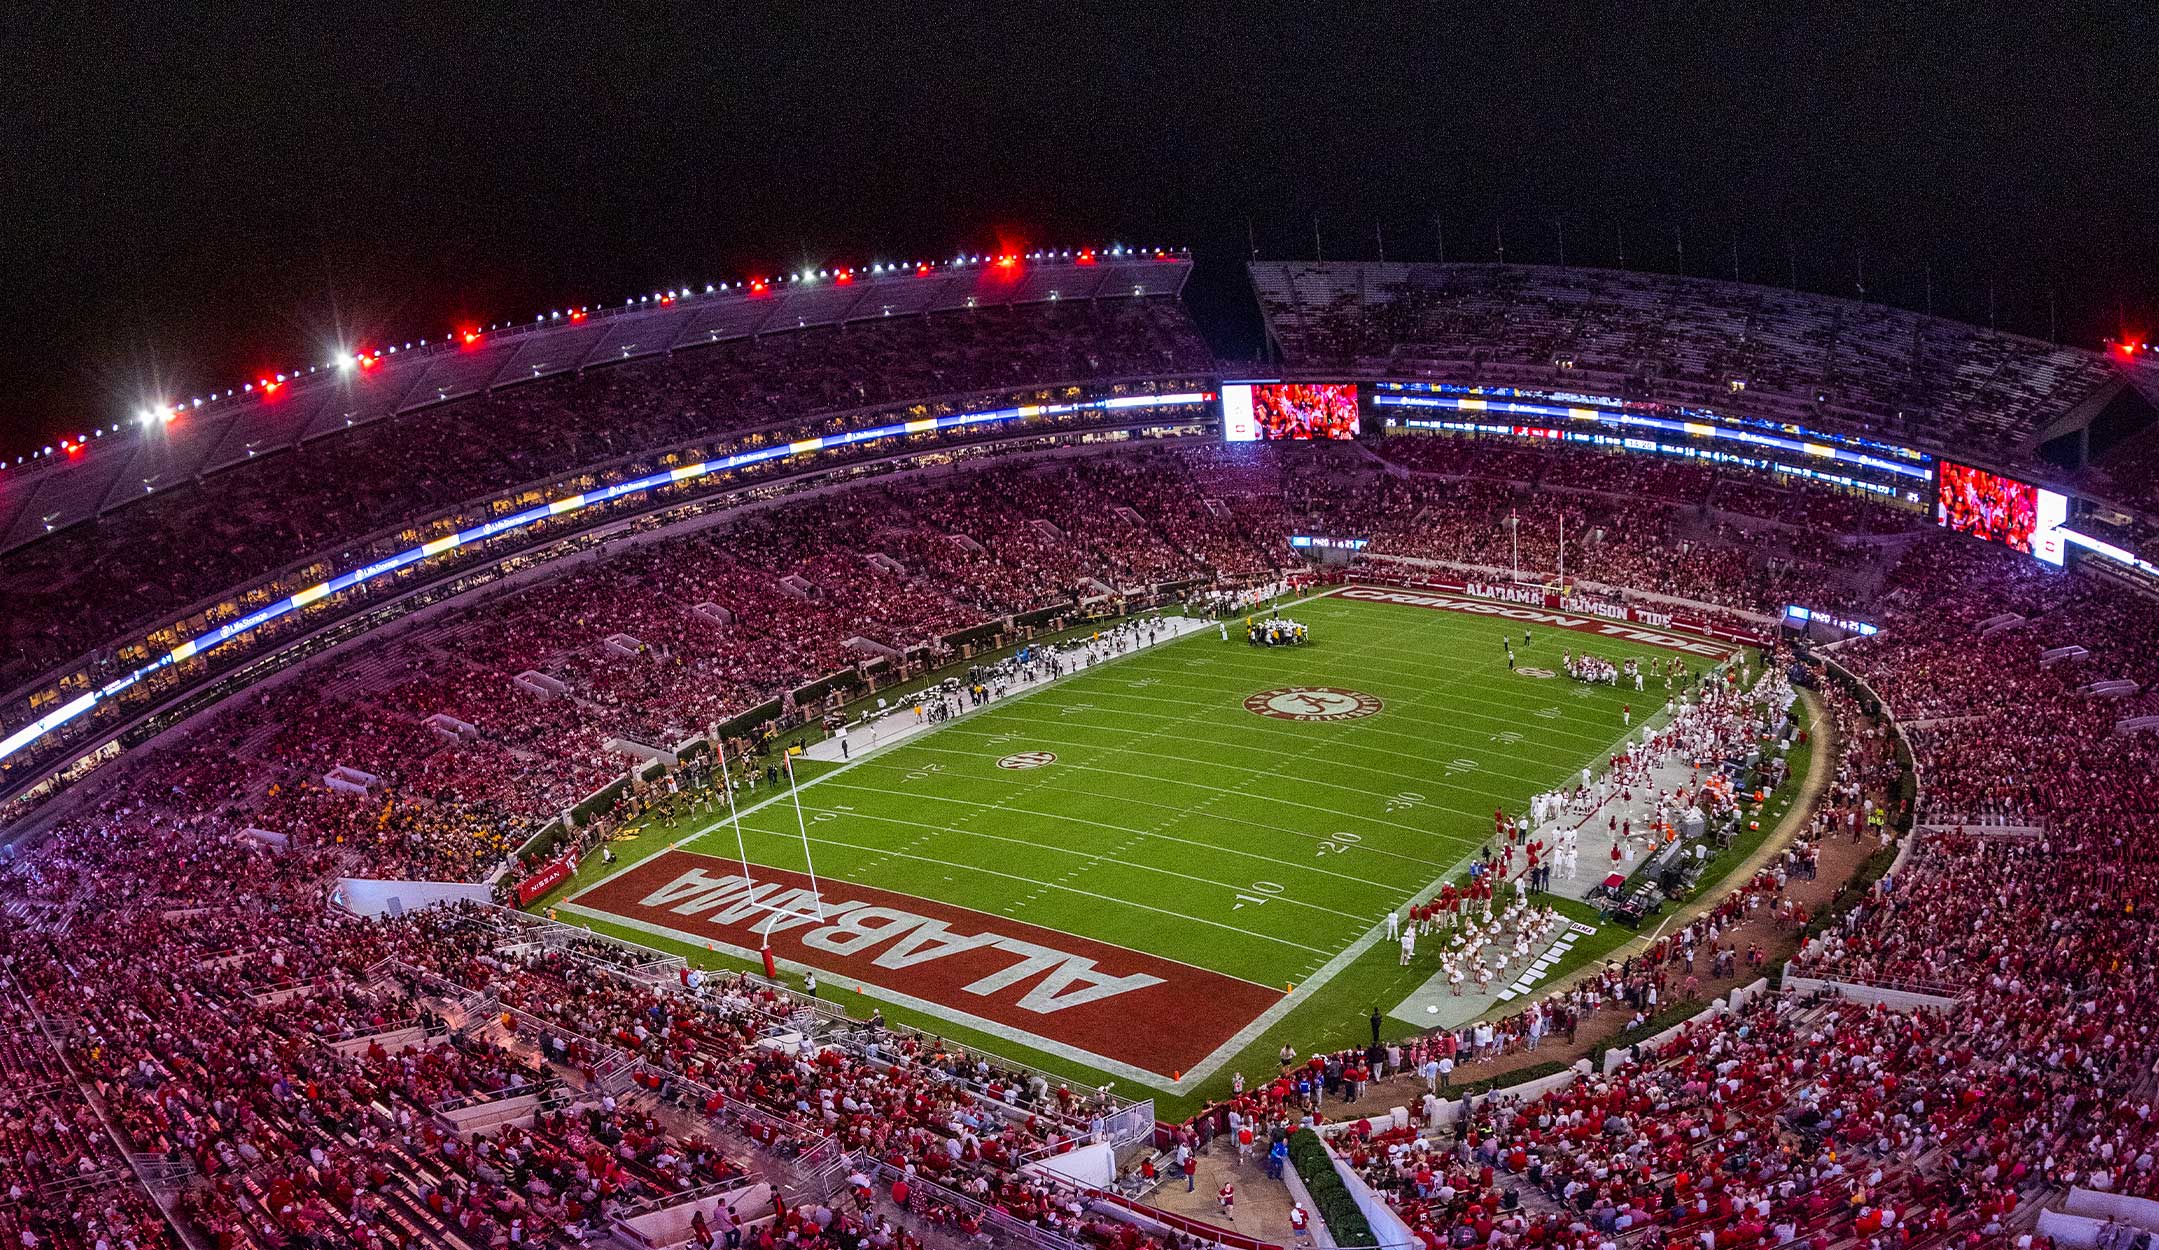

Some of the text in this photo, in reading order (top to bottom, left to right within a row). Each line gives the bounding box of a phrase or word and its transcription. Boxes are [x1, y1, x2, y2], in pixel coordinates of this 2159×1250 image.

[1342, 590, 1727, 656] CRIMSON TIDE
[1317, 831, 1362, 854] 20
[530, 871, 560, 892] NISSAN
[1235, 880, 1285, 906] 10
[1571, 923, 1593, 934] BAMA
[637, 867, 1168, 1015] ALABAMA
